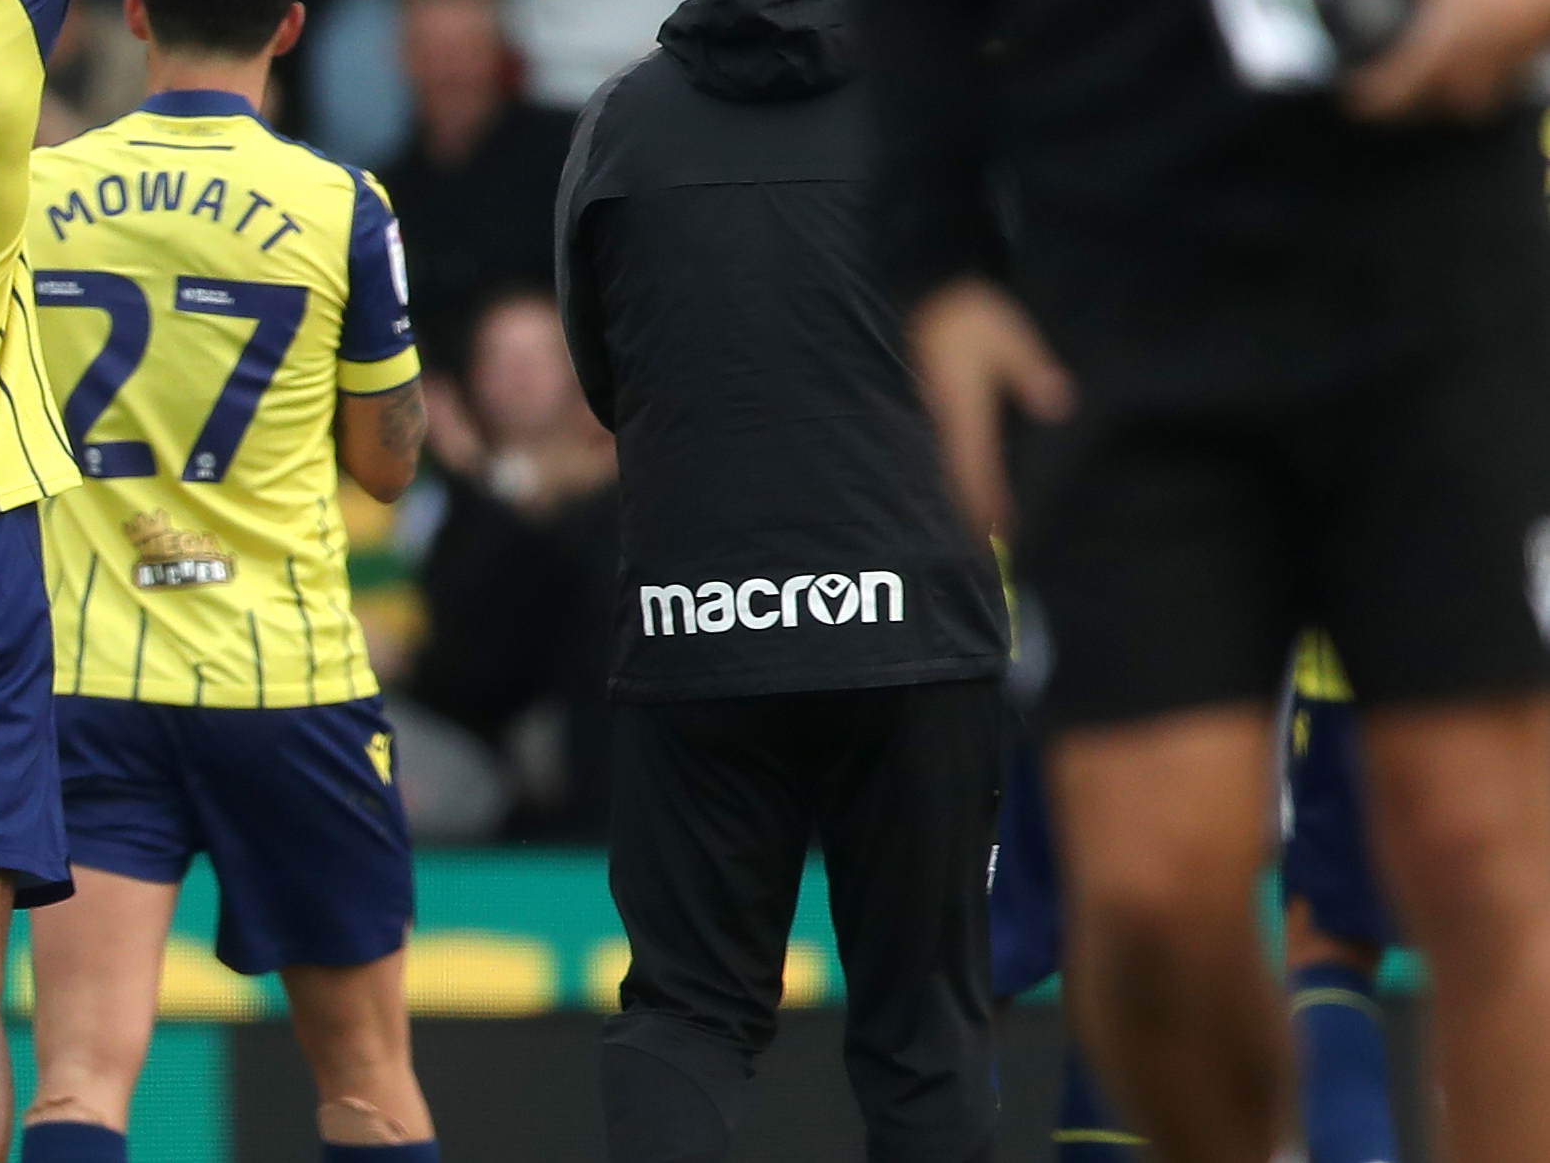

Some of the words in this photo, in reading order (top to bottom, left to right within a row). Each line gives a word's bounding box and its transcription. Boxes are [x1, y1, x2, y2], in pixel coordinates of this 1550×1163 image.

[45, 170, 302, 252] MOWATT
[34, 268, 309, 483] 27
[640, 570, 904, 636] macron
